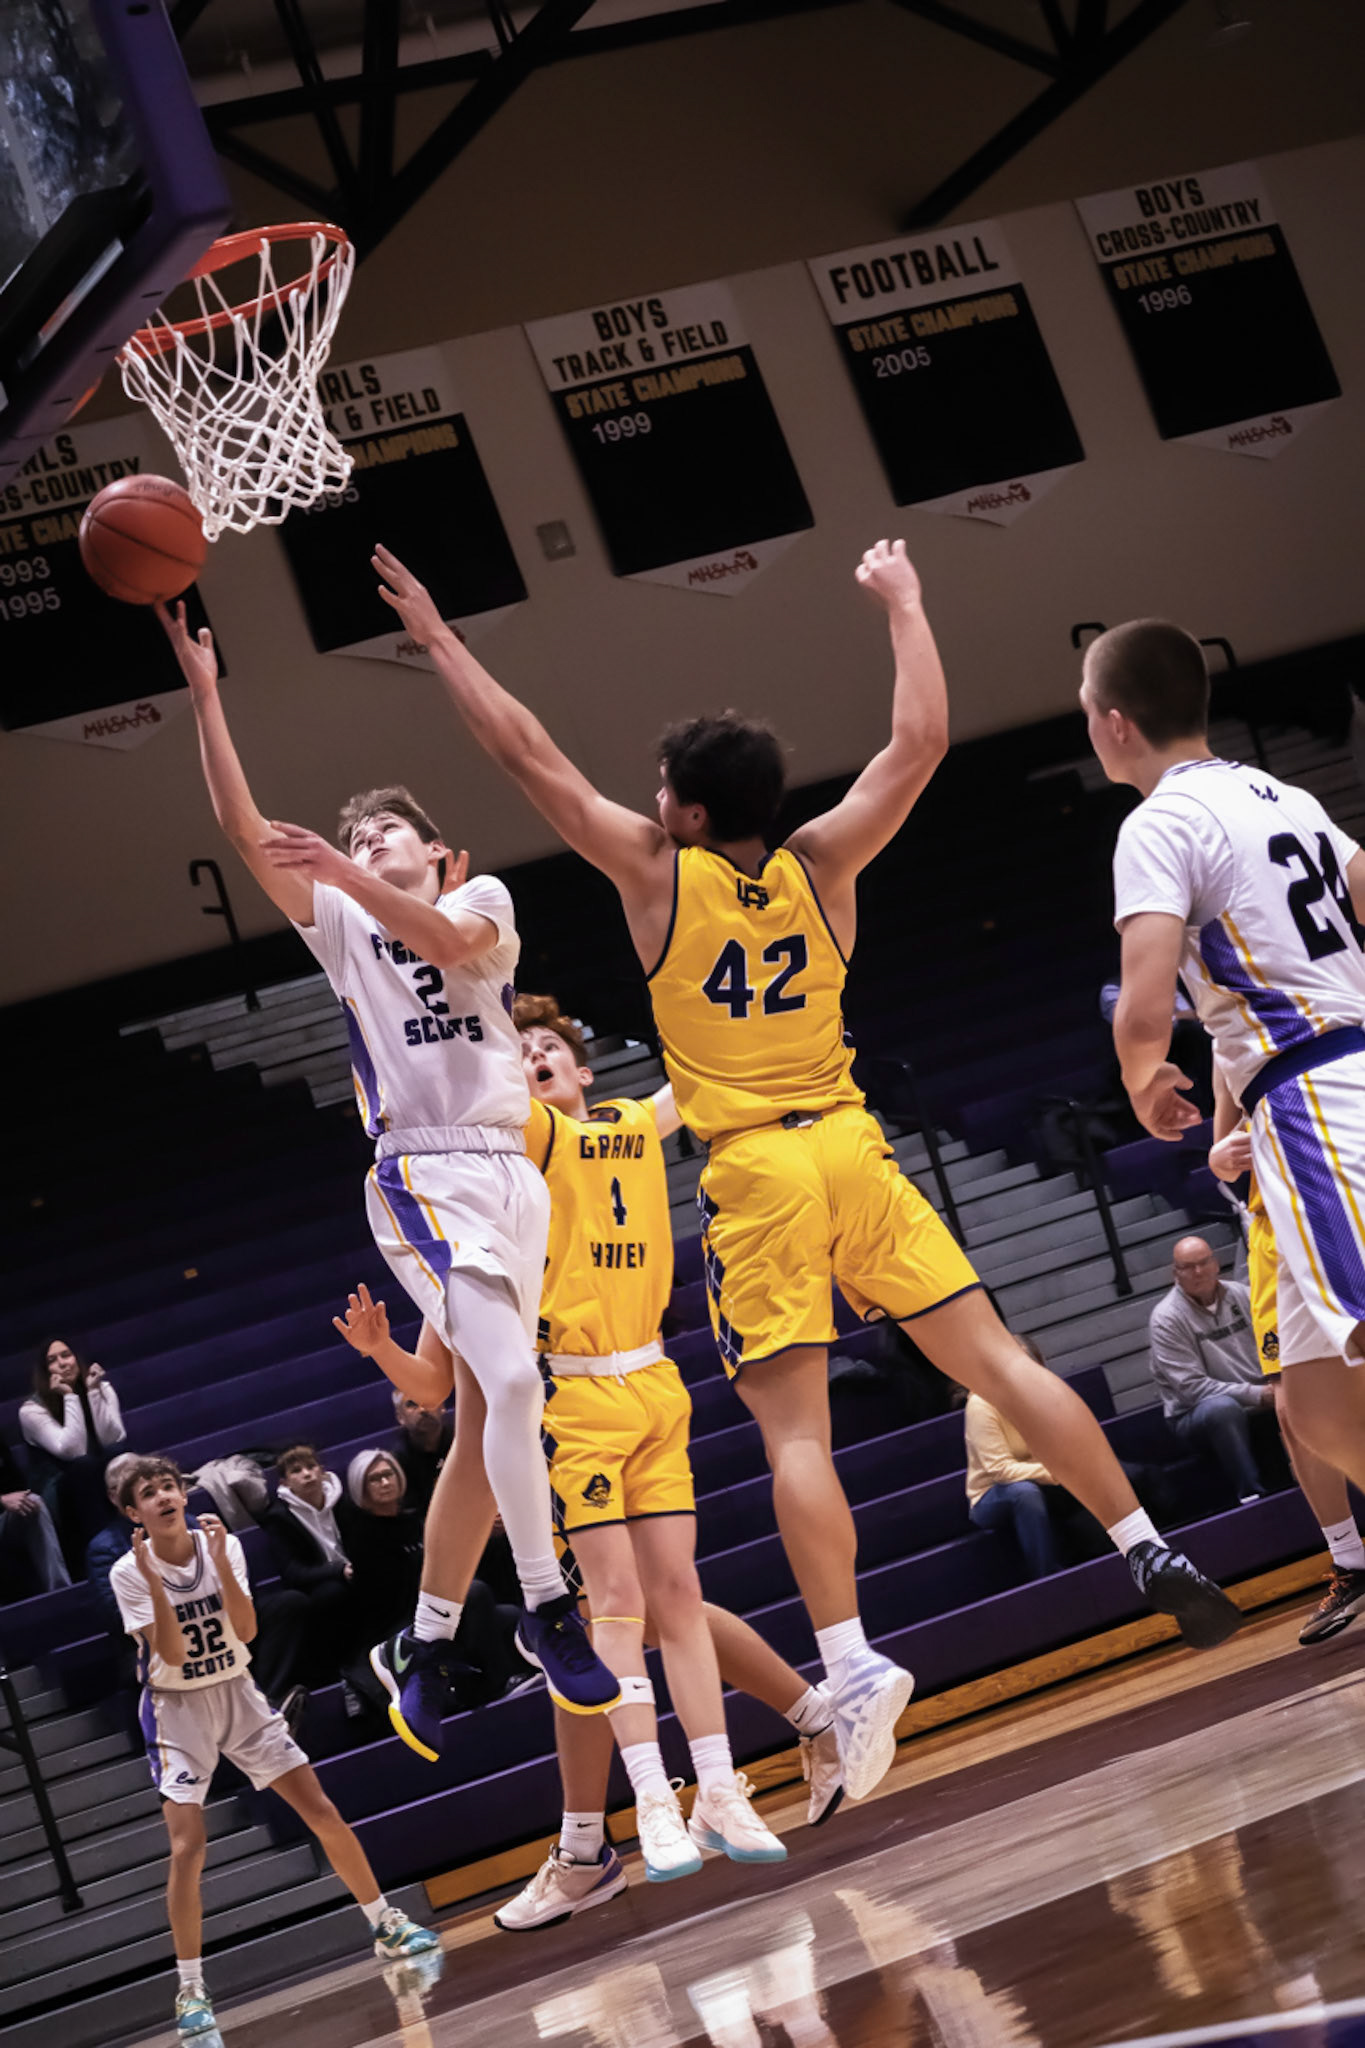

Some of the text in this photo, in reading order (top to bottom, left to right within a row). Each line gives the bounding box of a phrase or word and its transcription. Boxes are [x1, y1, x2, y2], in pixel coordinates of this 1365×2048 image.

[1134, 178, 1204, 218] BOYS
[1096, 198, 1262, 257] CROSS-COUNTRY
[829, 236, 999, 304] FOOTBALL
[1112, 232, 1276, 290] STATE CHAMPIONS
[592, 298, 668, 342] BOYS
[1138, 285, 1193, 314] 1996
[848, 292, 1019, 352] STATE CHAMPIONS
[552, 320, 730, 382] TRACK & FIELD
[872, 346, 932, 378] 2005
[564, 354, 747, 419] STATE CHAMPIONS
[344, 405, 363, 431] &
[370, 387, 441, 426] FIELD
[592, 412, 652, 443] 1999
[0, 556, 50, 587] 993
[412, 965, 450, 1014] 2
[702, 934, 809, 1019] 42
[579, 1133, 645, 1159] GRAND
[611, 1176, 627, 1226] 1
[174, 1591, 223, 1623] GHTIN
[181, 1617, 227, 1658] 32
[181, 1649, 236, 1681] SCOTS
